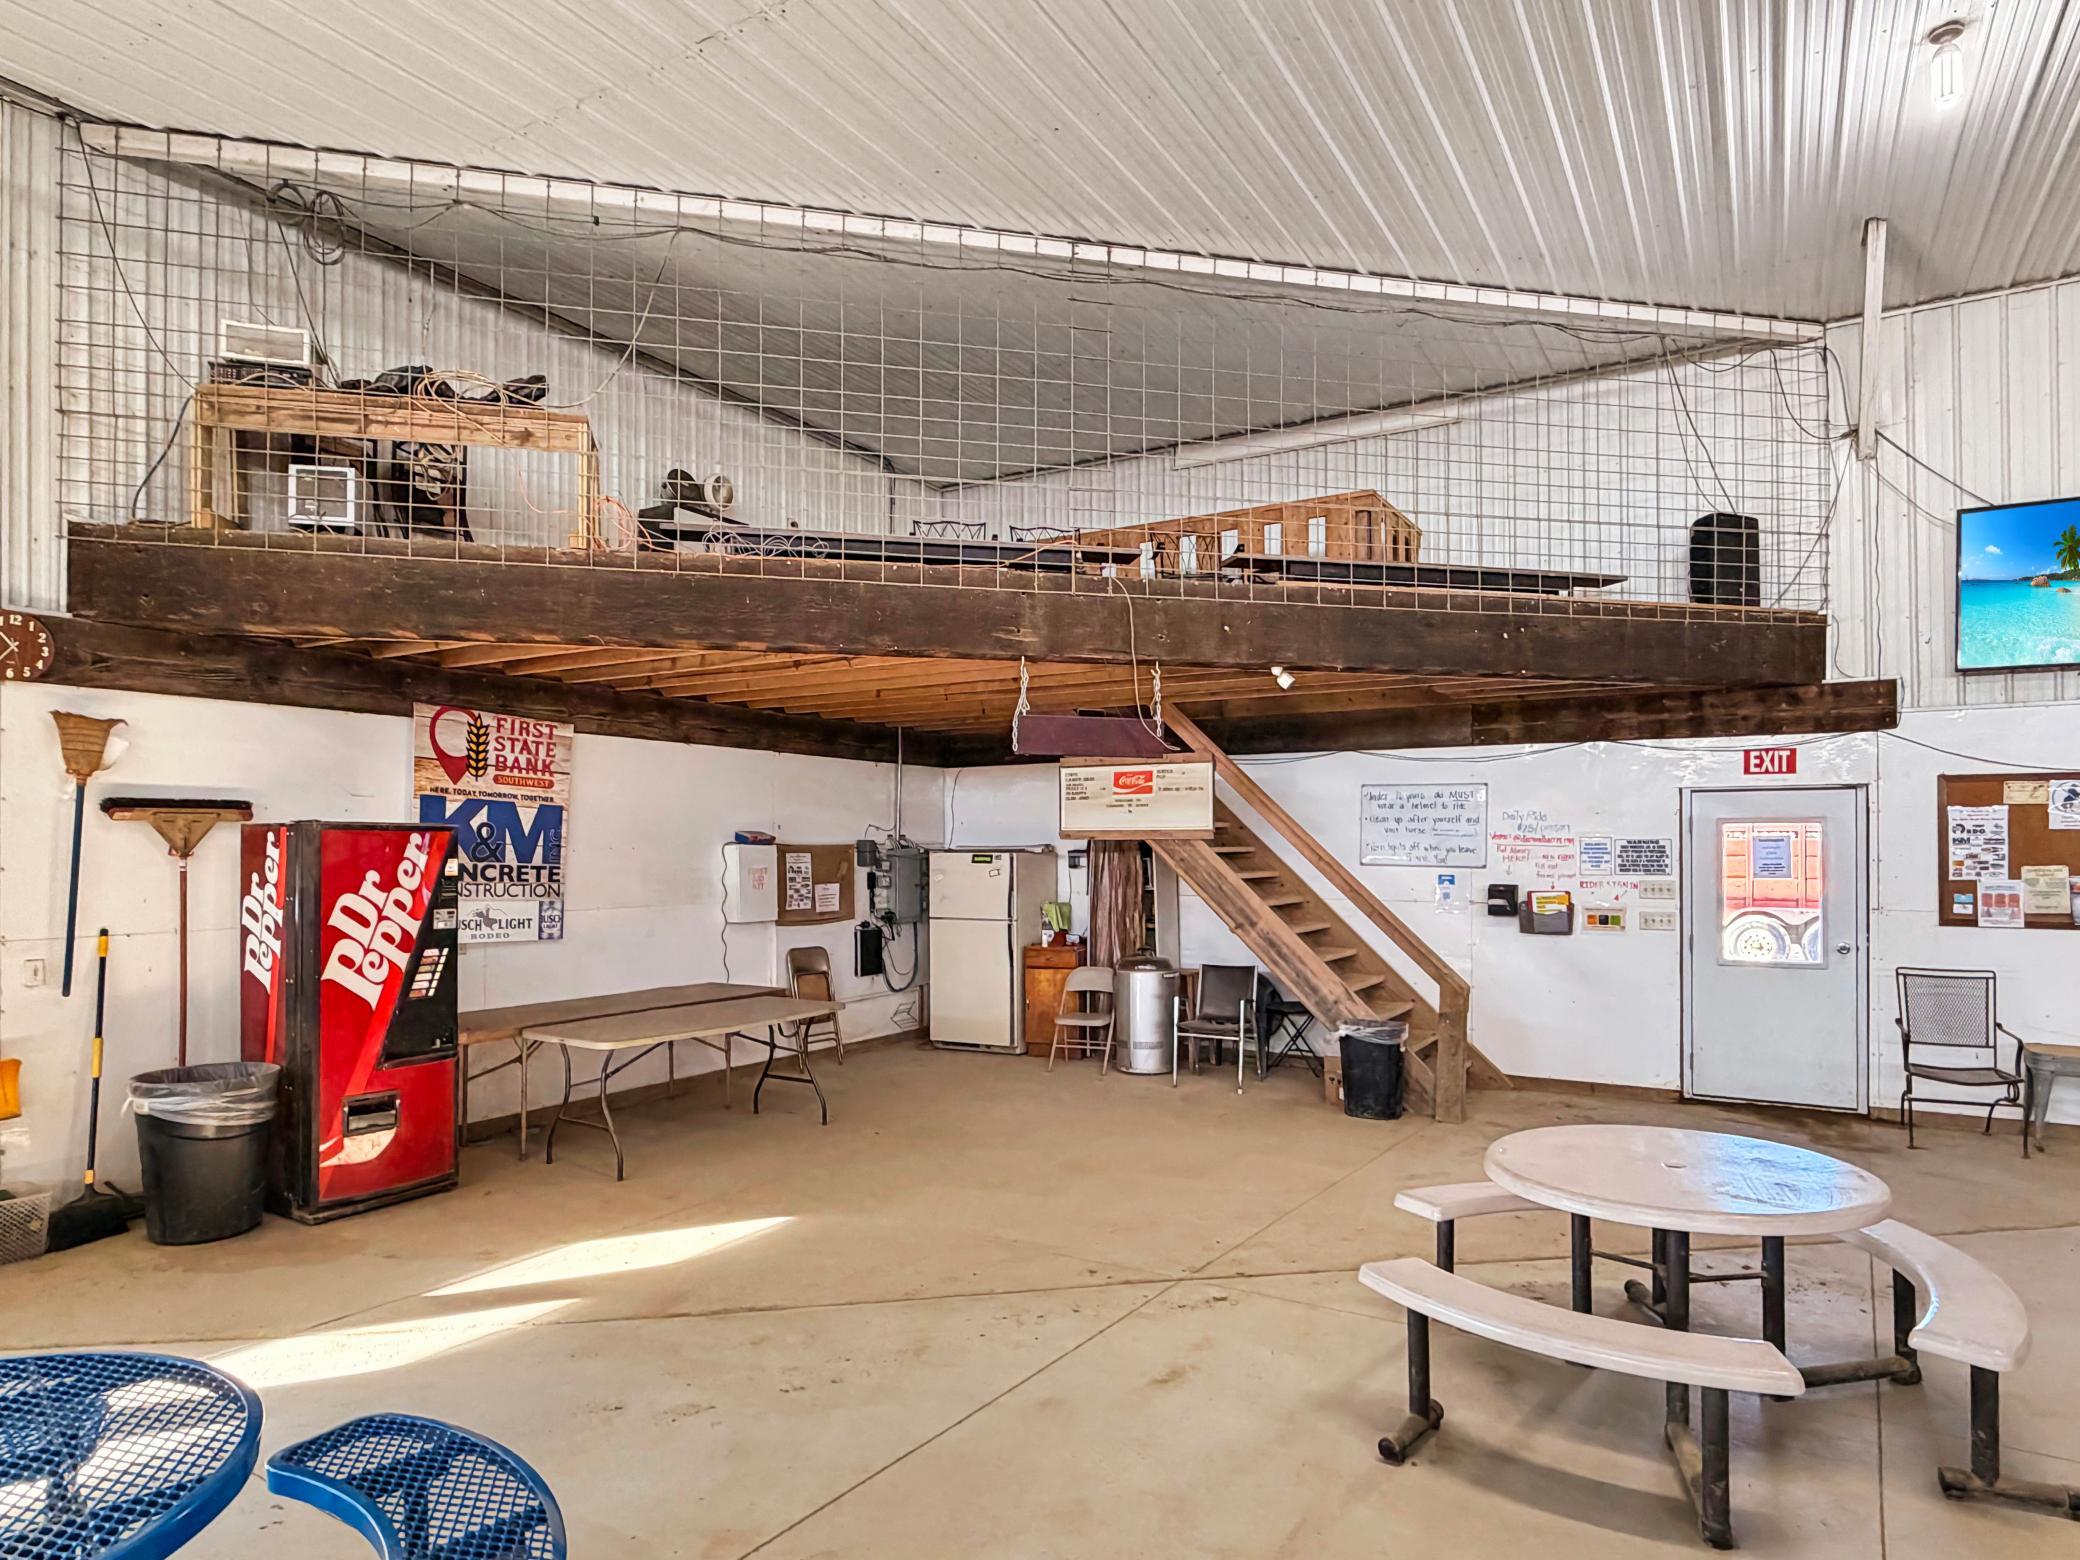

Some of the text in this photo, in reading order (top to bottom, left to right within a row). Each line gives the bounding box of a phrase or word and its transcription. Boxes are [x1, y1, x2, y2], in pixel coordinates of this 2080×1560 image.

[10, 615, 22, 625] 12
[29, 621, 35, 631] 1
[38, 633, 46, 643] 2
[41, 647, 49, 657] 3
[35, 660, 43, 669] 4
[6, 668, 14, 678] 6
[23, 667, 31, 677] 5
[496, 717, 557, 740] FIRST
[494, 735, 556, 760] STATE
[495, 754, 555, 780] BANK
[1750, 750, 1791, 772] EXIT
[497, 775, 550, 788] SOUTHWEST
[1449, 791, 1475, 801] MUST
[1432, 815, 1462, 824] yourself
[1467, 815, 1481, 825] and
[420, 795, 564, 864] K&M
[458, 863, 560, 883] NCRETE
[458, 883, 560, 898] STRUCTION
[242, 872, 264, 941] Dr
[244, 831, 284, 995] Pepper
[327, 870, 389, 950] Dr
[320, 832, 429, 1011] Pepper
[498, 918, 533, 929] LIGHT
[470, 932, 511, 940] RODEO
